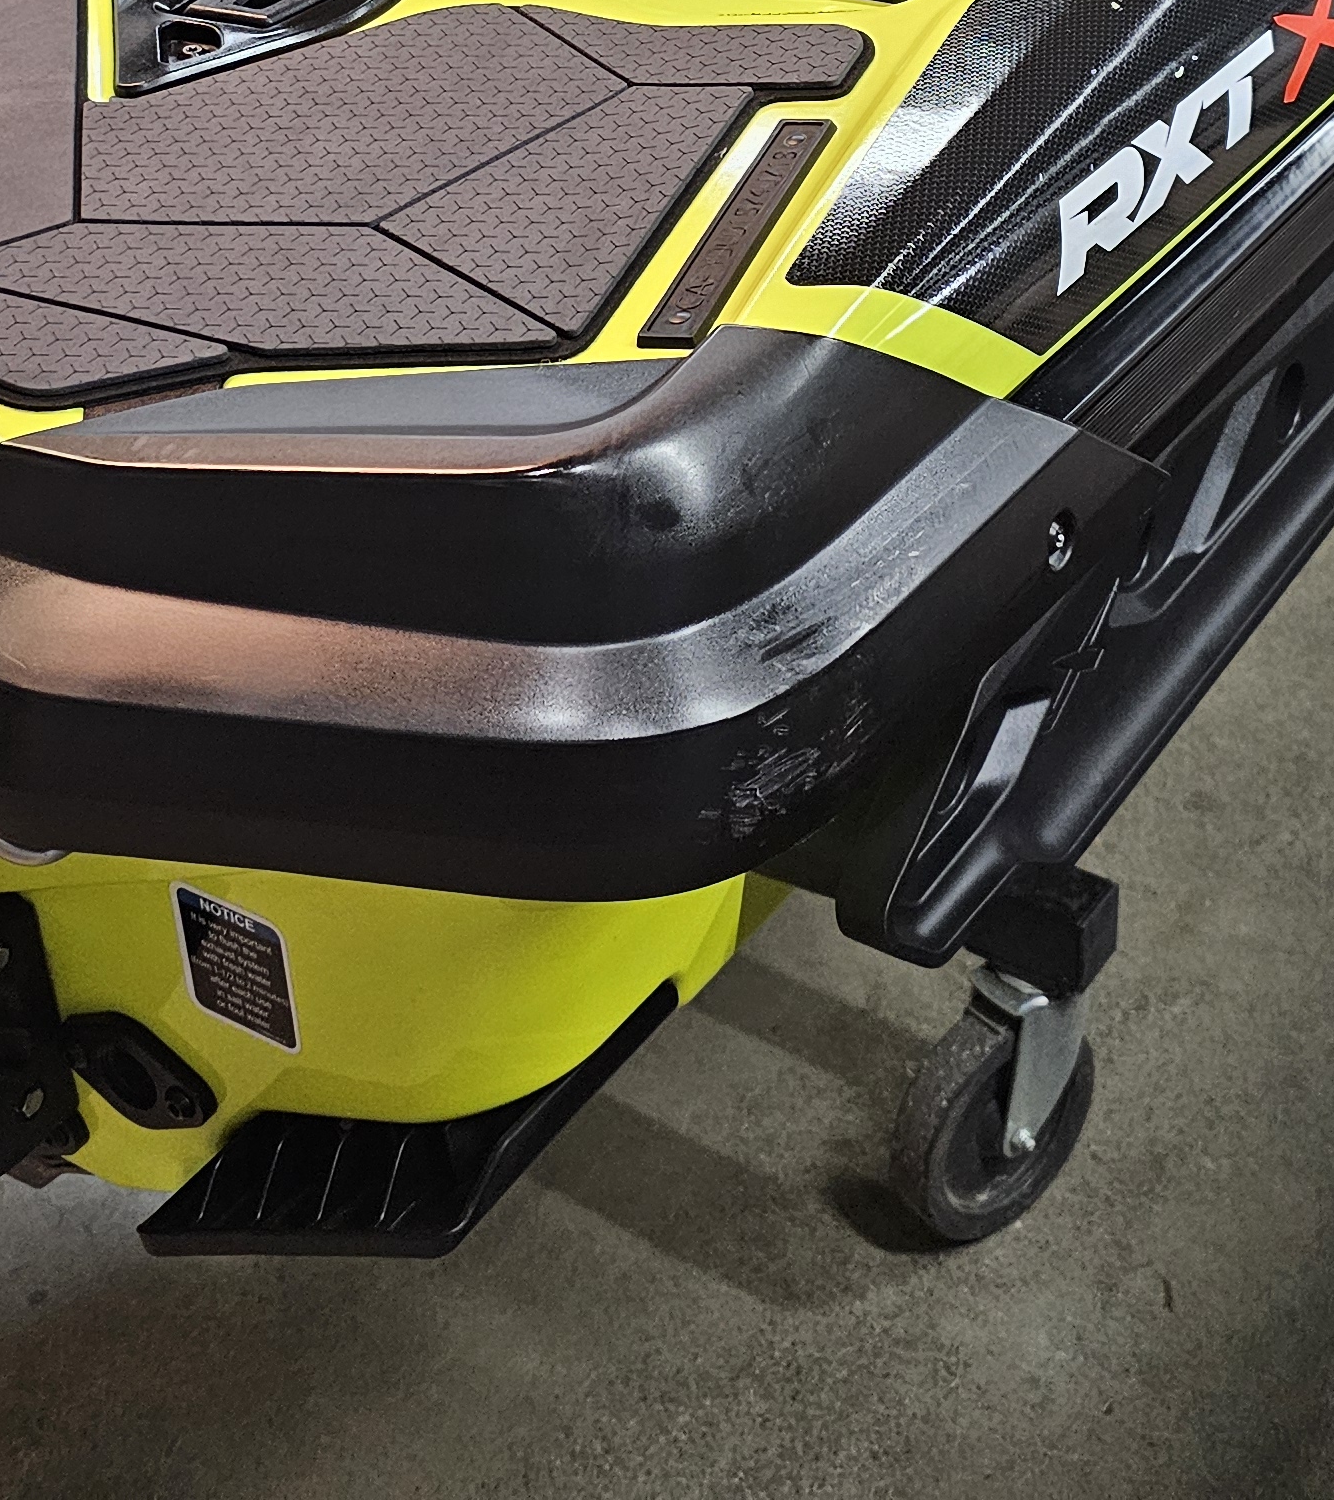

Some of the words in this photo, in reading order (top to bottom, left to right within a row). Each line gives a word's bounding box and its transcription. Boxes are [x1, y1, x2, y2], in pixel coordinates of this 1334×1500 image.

[1056, 29, 1275, 297] RXT
[199, 898, 256, 933] NOTICE
[198, 916, 206, 925] is
[208, 920, 228, 936] very
[230, 929, 272, 956] important
[208, 930, 217, 940] to
[219, 935, 240, 951] flush
[243, 945, 258, 959] the
[201, 939, 236, 961] exhaust
[238, 955, 269, 977] system
[203, 950, 220, 964] with
[222, 958, 245, 976] fresh
[247, 970, 271, 987] water
[245, 1002, 269, 1017] water
[256, 995, 272, 1010] use
[247, 1012, 270, 1029] water
